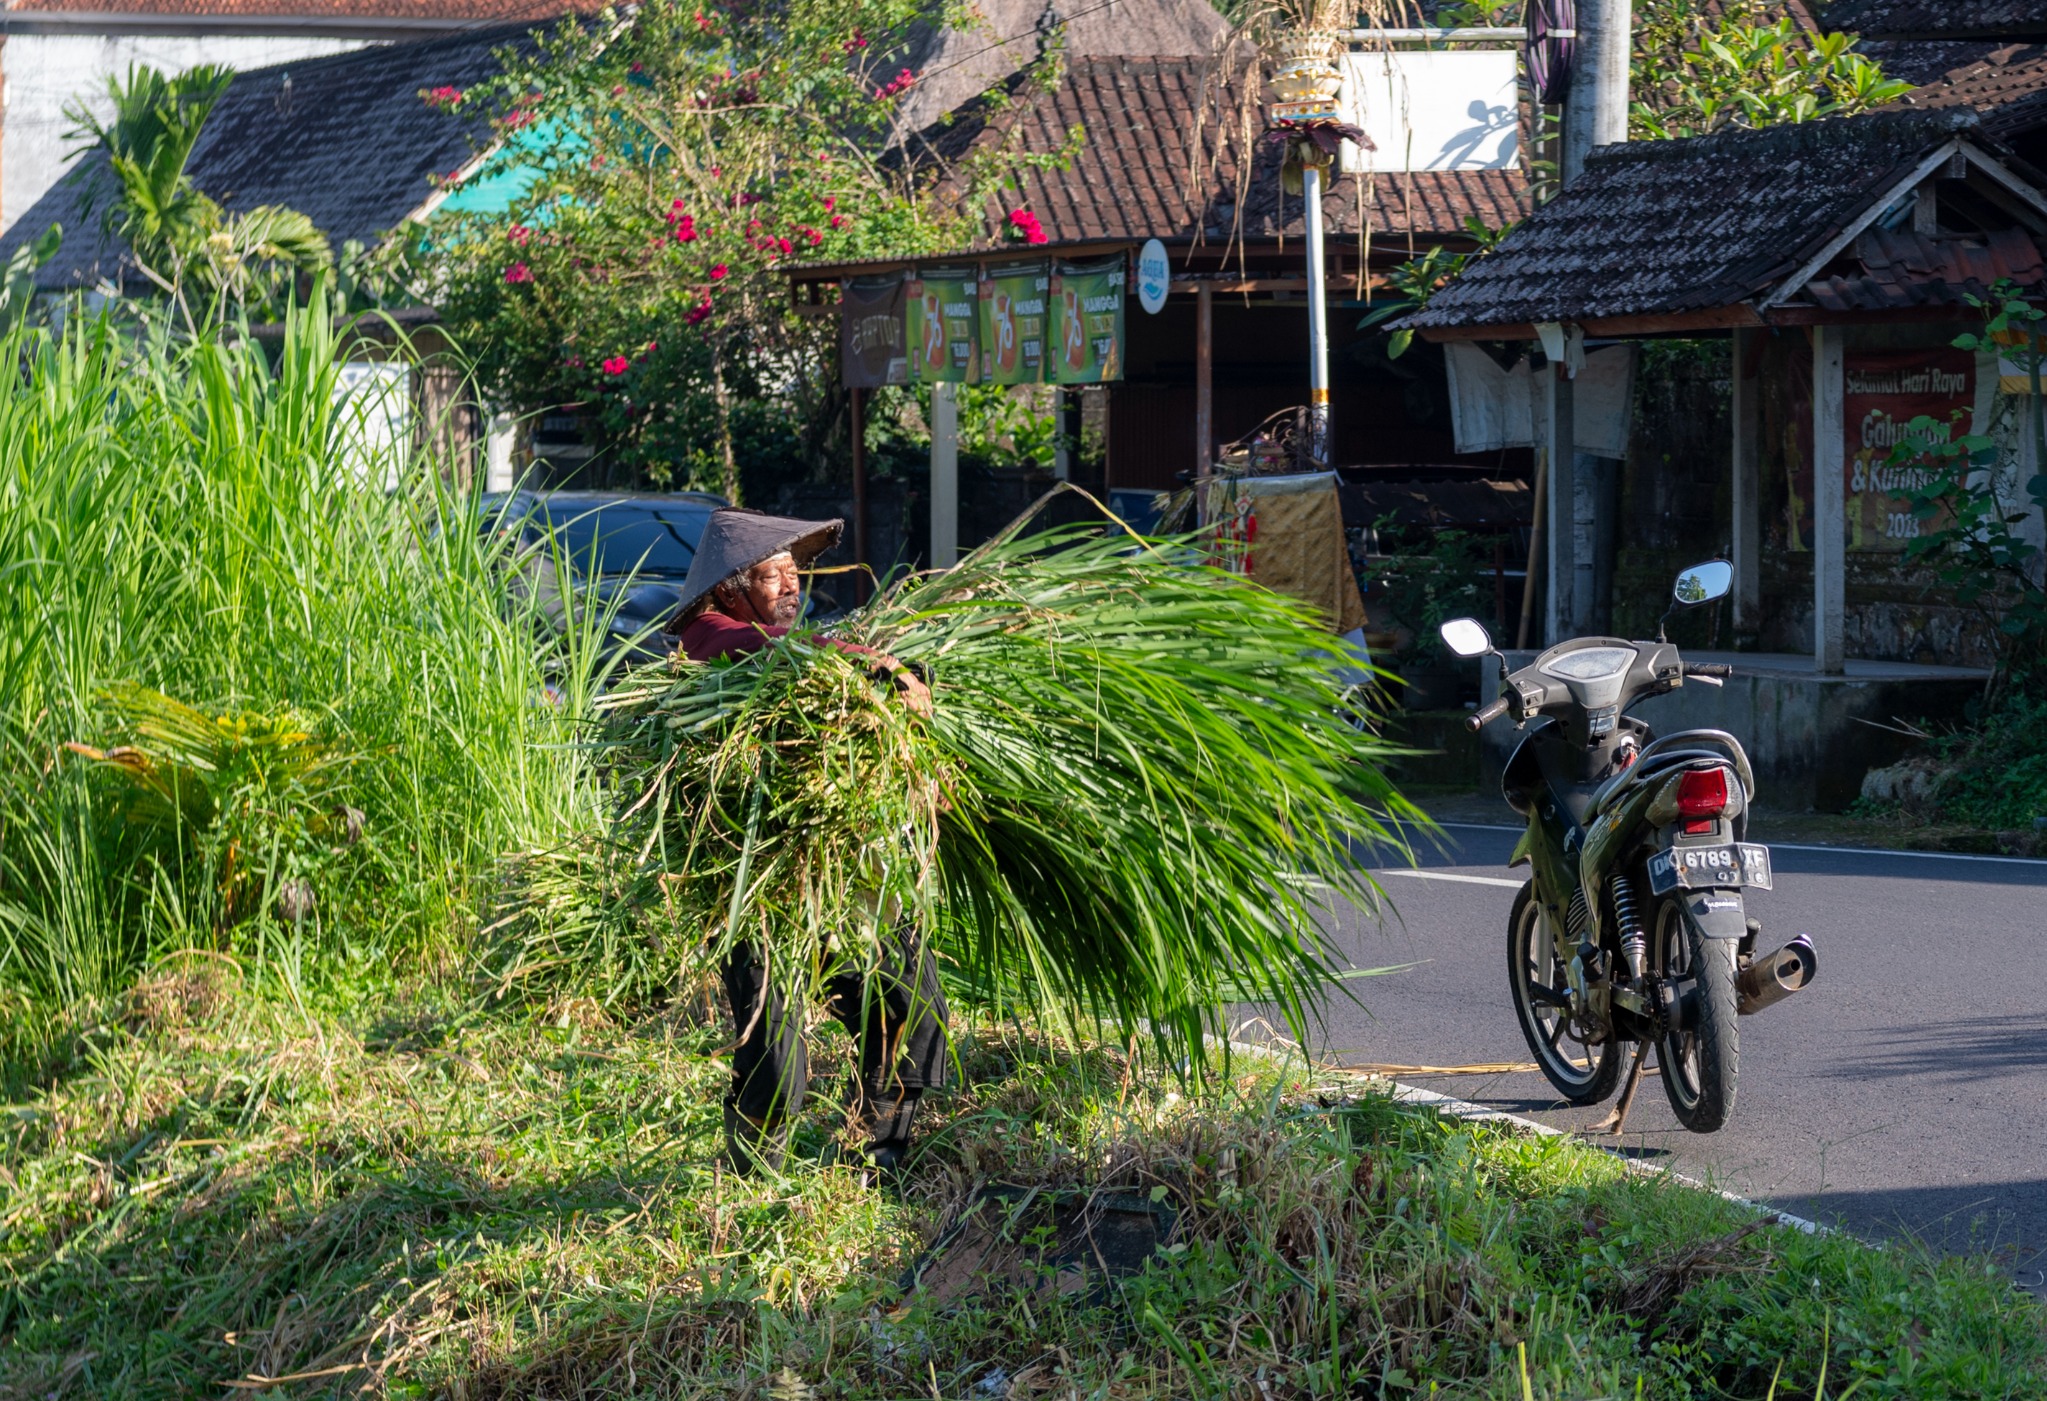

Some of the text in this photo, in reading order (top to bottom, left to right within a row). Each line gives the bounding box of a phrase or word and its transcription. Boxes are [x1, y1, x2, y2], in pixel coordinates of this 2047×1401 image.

[1141, 258, 1164, 281] AQUA
[944, 303, 972, 317] MANGGA
[1015, 299, 1044, 316] MANGGA
[1083, 294, 1119, 313] MANGGA
[1847, 367, 1966, 400] Selamat Hari Raya
[1862, 415, 1951, 456] Galuan
[1850, 459, 1866, 492] &
[1886, 512, 1920, 538] 2023
[1685, 850, 1732, 868] 6789
[1742, 848, 1764, 868] XF
